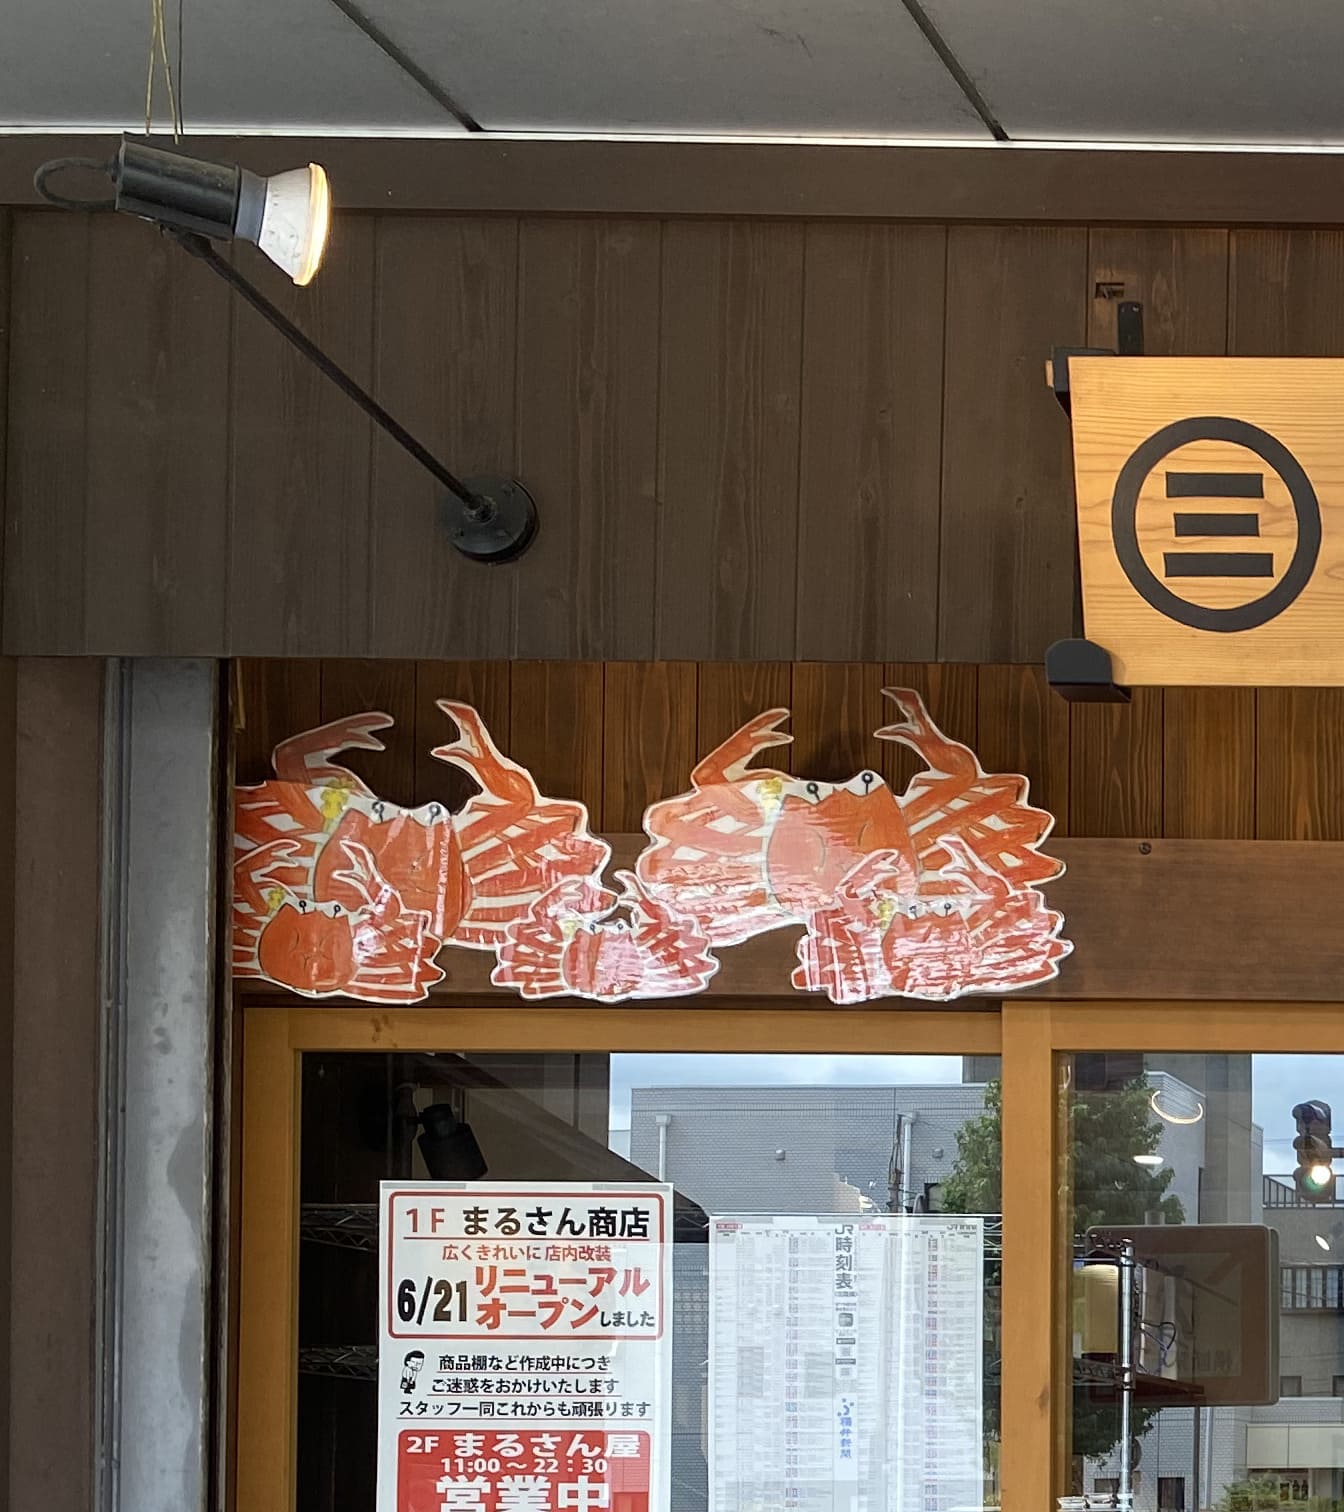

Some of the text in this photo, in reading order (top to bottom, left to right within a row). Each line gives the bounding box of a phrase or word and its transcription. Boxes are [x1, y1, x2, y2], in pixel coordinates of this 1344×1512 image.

[405, 1207, 649, 1237] 1F まるさん商店
[442, 1245, 612, 1262] 広くきれいに店内改装
[475, 1266, 650, 1297] リニューアル
[398, 1277, 467, 1325] 6/21
[476, 1297, 655, 1330] オープン しました
[439, 1355, 611, 1372] 商品棚など作成中につき
[432, 1378, 619, 1395] ご迷惑をおかけいたします
[399, 1401, 651, 1417] スタッフ一同これからも頑張ります
[407, 1434, 640, 1458] 2F まるさん屋
